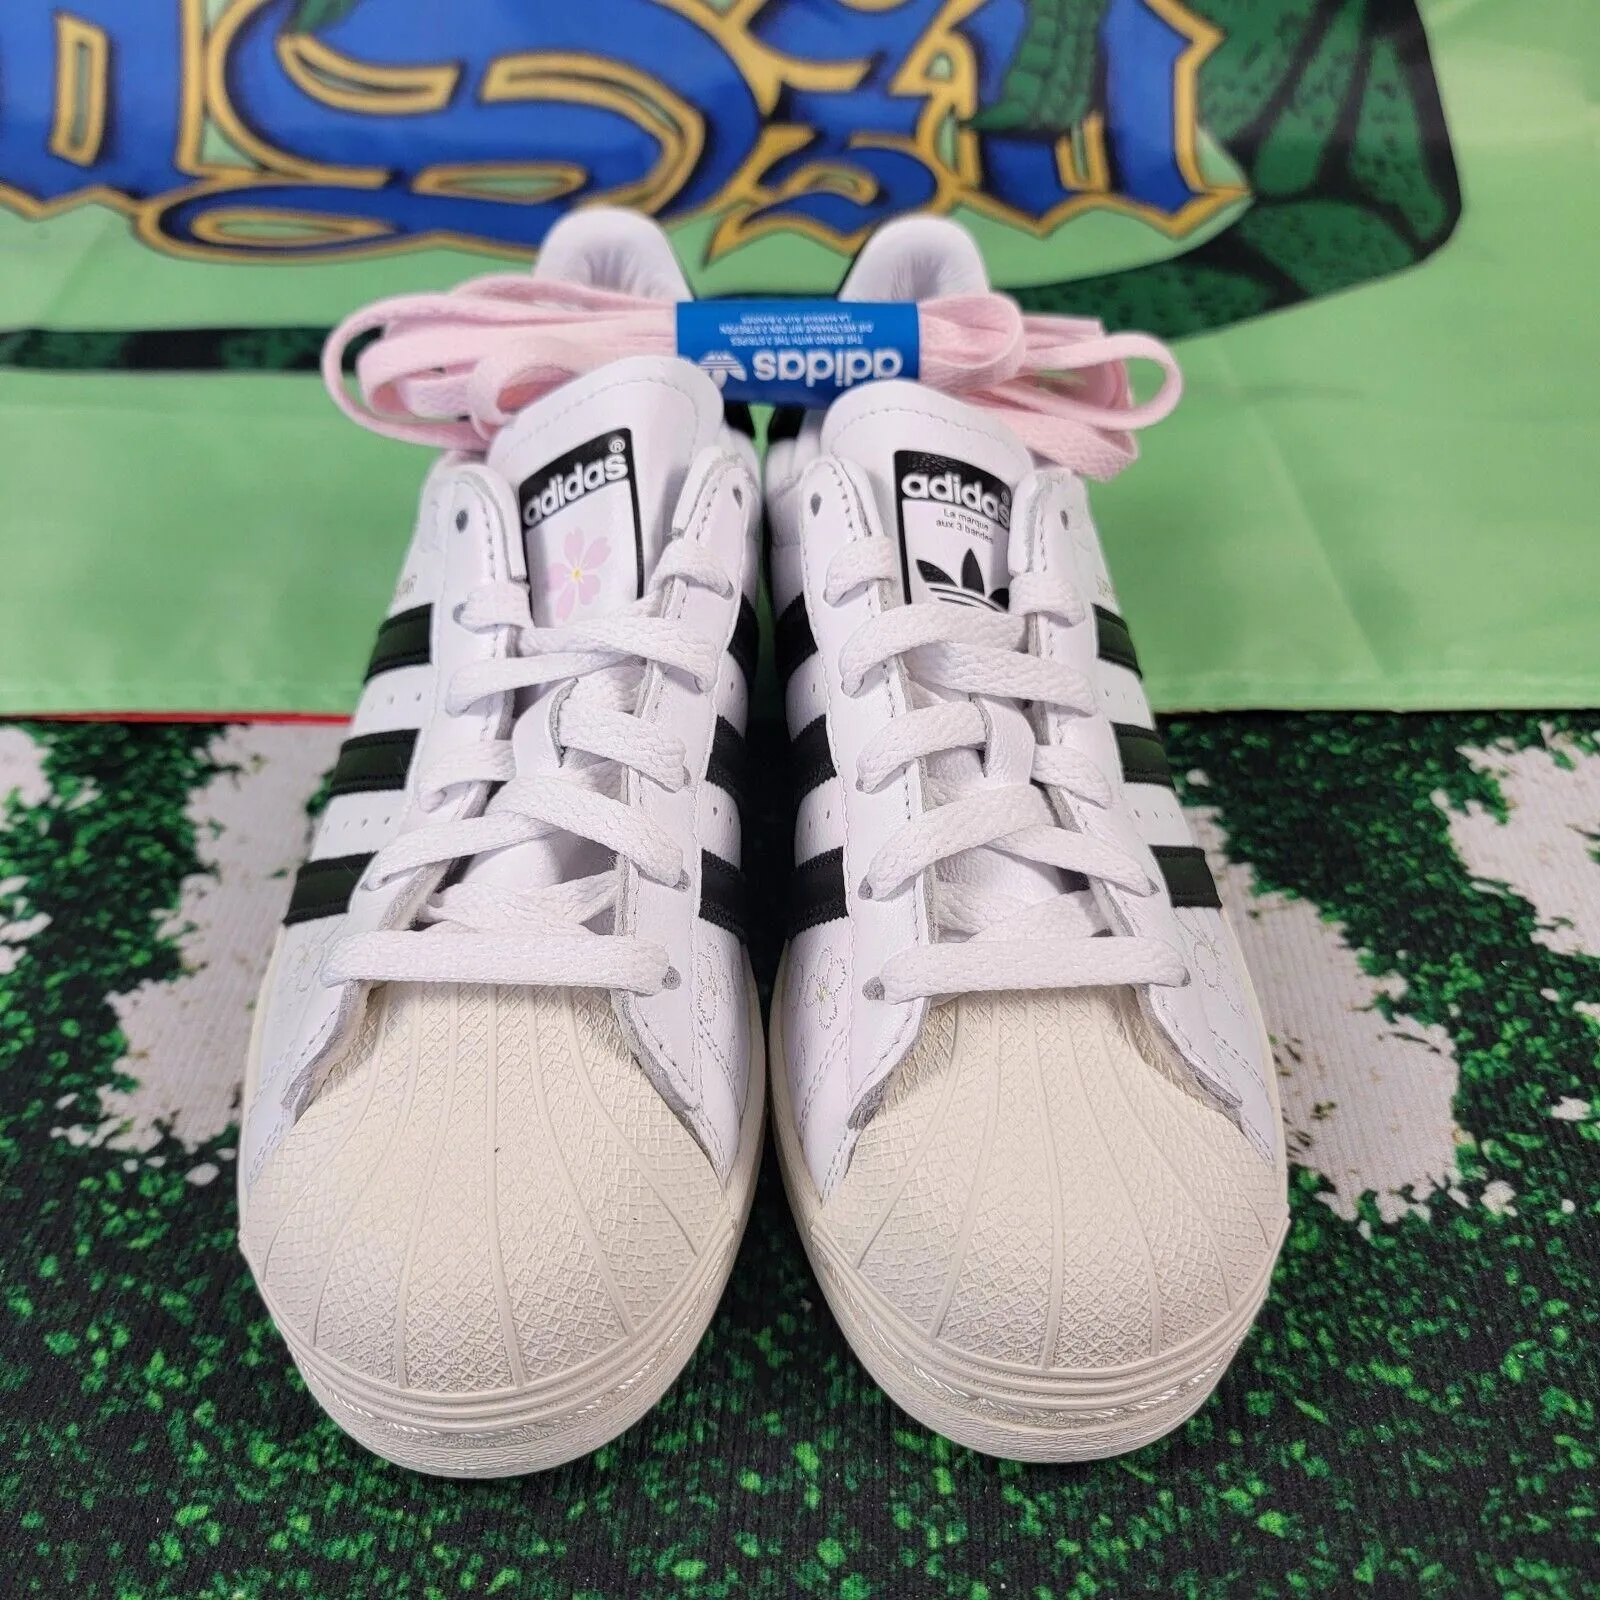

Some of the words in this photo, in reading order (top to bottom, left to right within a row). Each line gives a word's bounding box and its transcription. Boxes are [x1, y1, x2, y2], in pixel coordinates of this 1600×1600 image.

[752, 347, 903, 388] adidas
[524, 453, 629, 528] adidas
[902, 471, 1010, 531] adidas
[936, 519, 953, 529] aux
[956, 521, 962, 531] 3
[943, 508, 956, 518] La
[959, 514, 989, 532] marque
